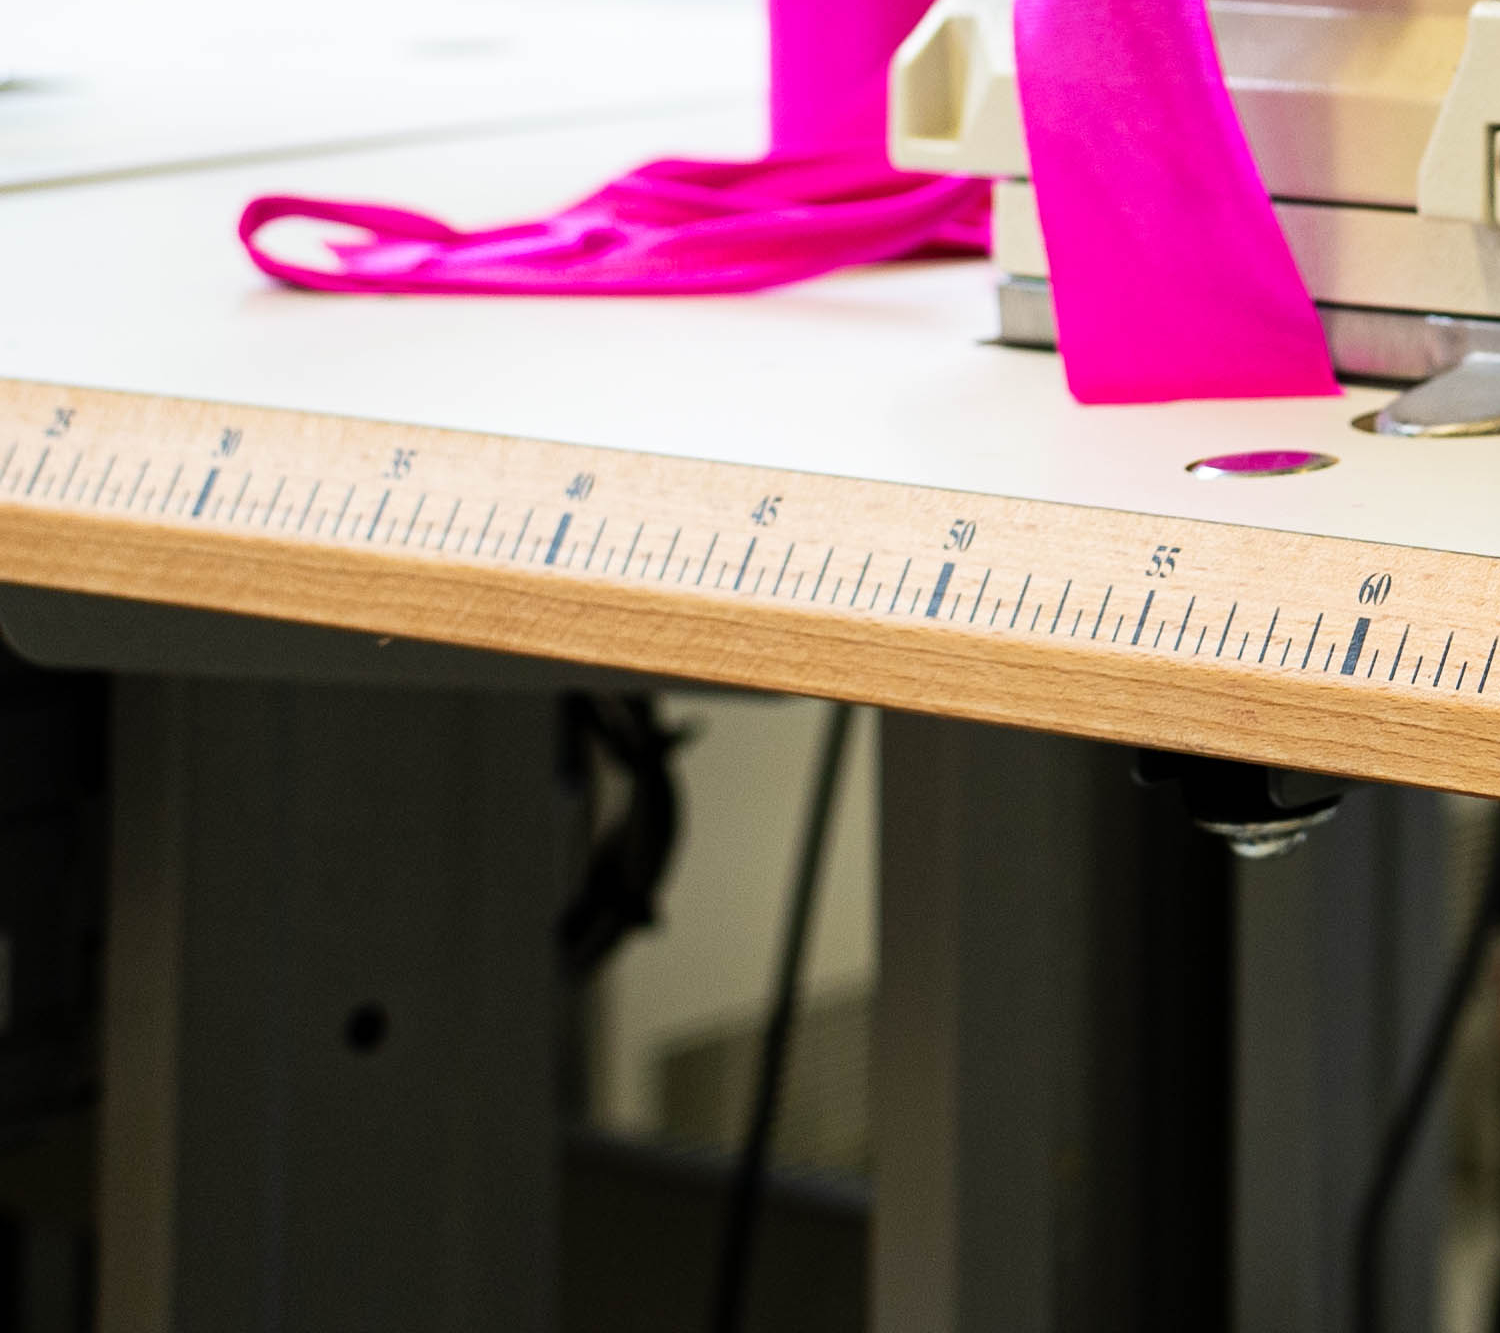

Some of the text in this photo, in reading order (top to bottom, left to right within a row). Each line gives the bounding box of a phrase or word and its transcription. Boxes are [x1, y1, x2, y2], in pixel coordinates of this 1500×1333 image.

[564, 471, 596, 502] 40
[748, 494, 784, 528] 45
[941, 519, 978, 553] 50
[1144, 544, 1182, 578] 55
[1357, 571, 1393, 607] 60
